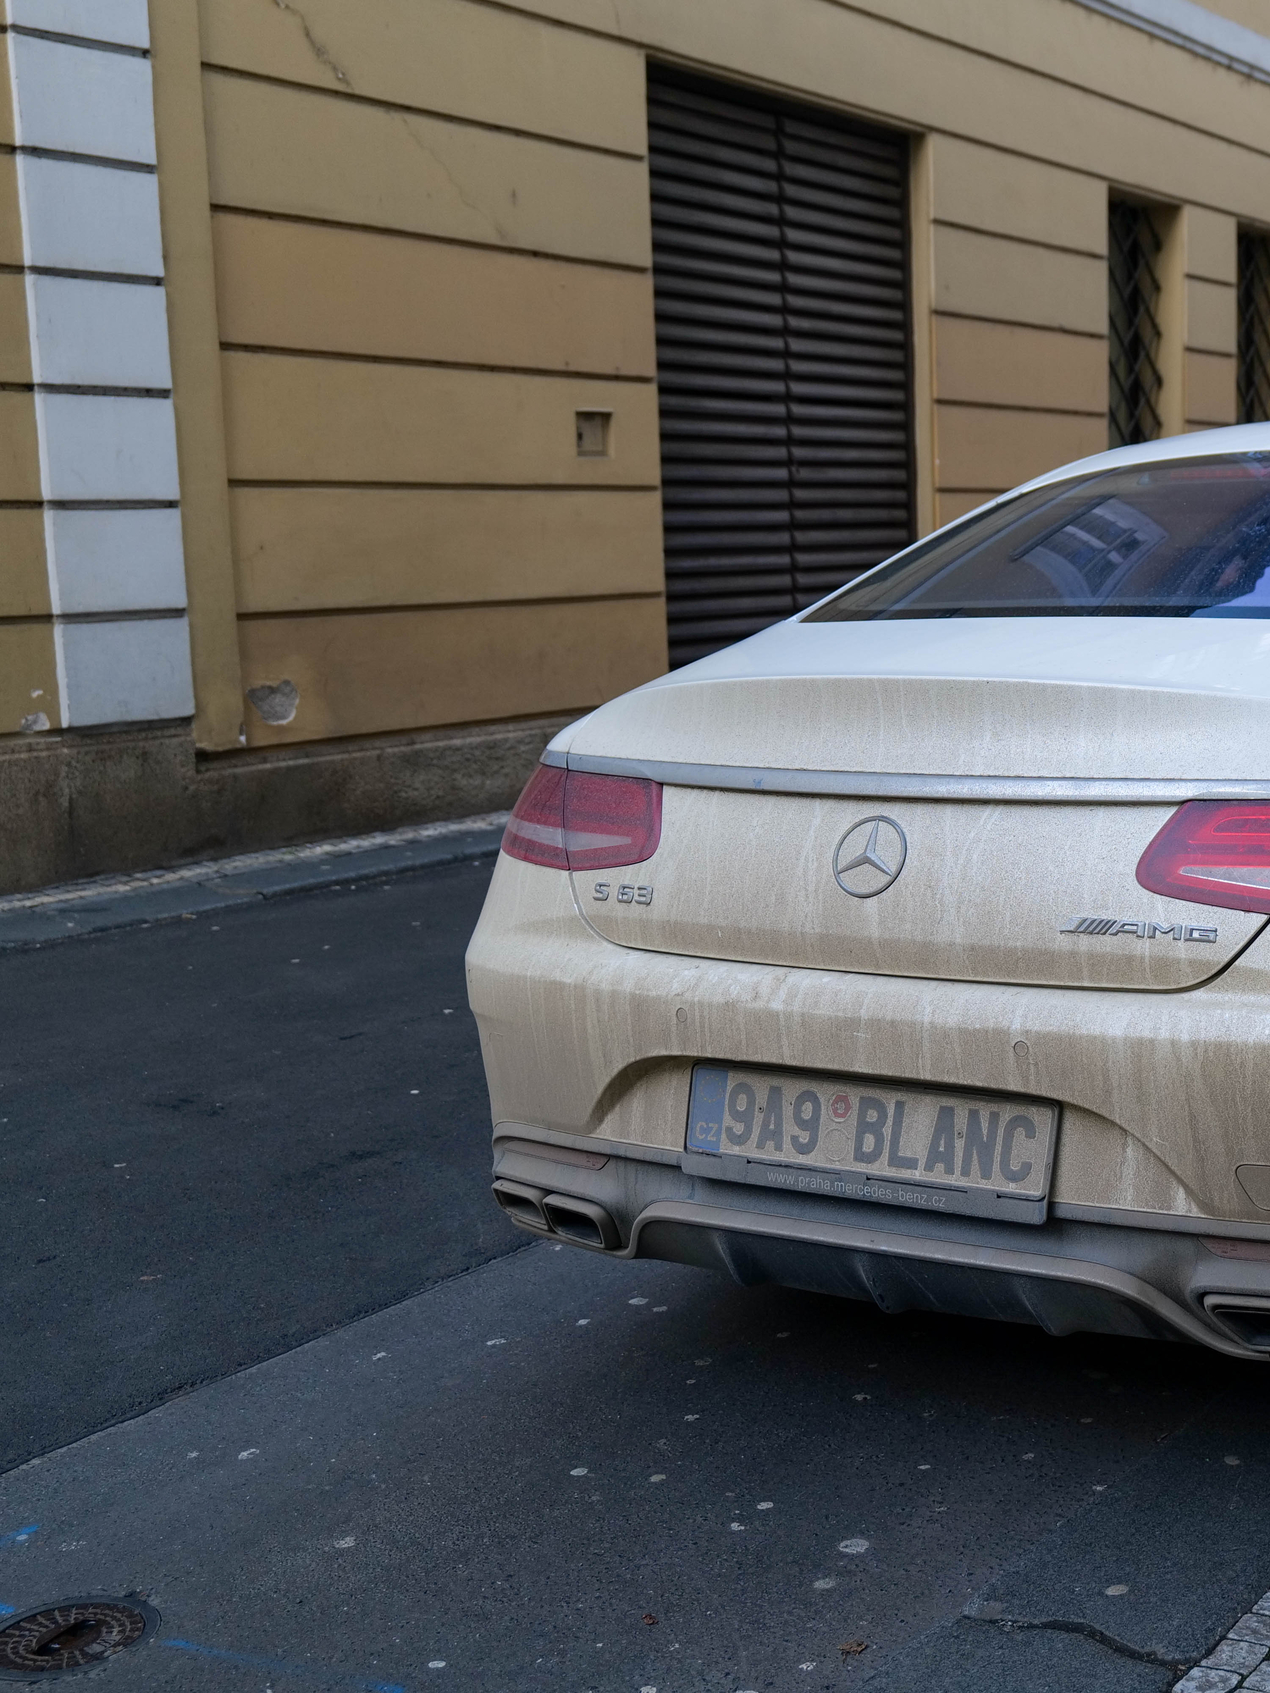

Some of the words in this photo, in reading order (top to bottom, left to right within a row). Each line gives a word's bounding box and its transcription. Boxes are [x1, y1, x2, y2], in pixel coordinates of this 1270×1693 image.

[593, 882, 610, 901] S
[617, 884, 653, 905] 63
[1108, 919, 1218, 943] AMG
[696, 1122, 718, 1141] CZ
[725, 1082, 822, 1155] 9A9
[853, 1096, 1037, 1183] BLANC
[767, 1170, 946, 1208] www.praha.mercedes-benz.cz
